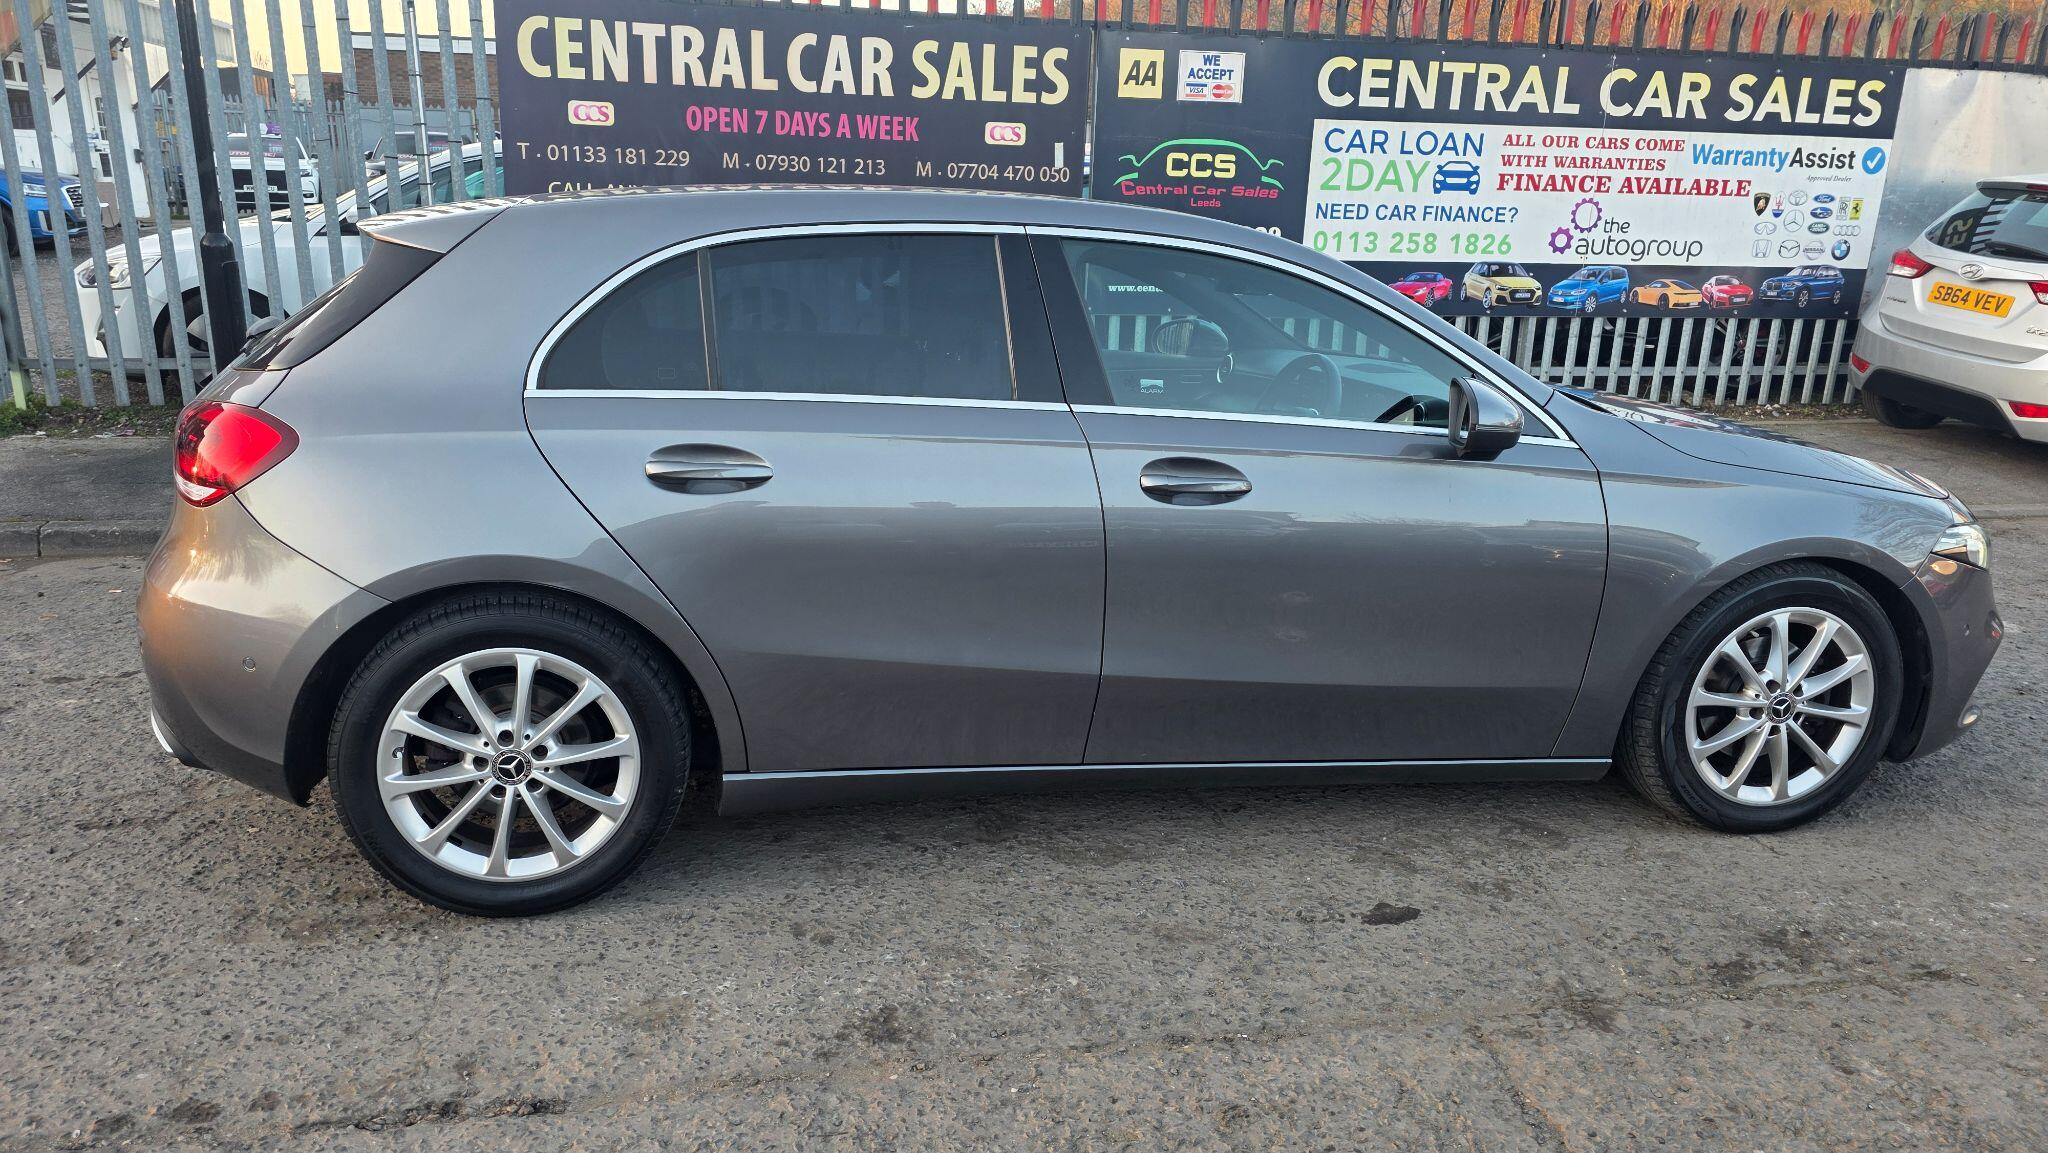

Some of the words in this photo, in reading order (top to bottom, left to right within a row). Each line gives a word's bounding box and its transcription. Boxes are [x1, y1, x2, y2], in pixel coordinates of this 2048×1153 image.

[517, 15, 779, 91] CENTRAL
[786, 32, 895, 97] CAR
[911, 39, 1070, 105] SALES
[1203, 54, 1221, 67] WE
[1123, 60, 1158, 86] AA
[1188, 68, 1234, 80] ACCEPT
[1317, 55, 1580, 115] CENTRAL
[1599, 68, 1711, 120] CAR
[1723, 73, 1886, 127] SALES
[573, 104, 610, 122] CCS
[686, 105, 748, 134] OPEN
[755, 110, 769, 134] 7
[775, 110, 831, 137] DAYS
[836, 113, 851, 138] A
[856, 114, 920, 142] WEEK
[989, 125, 1022, 143] CCS
[1324, 127, 1389, 154] CAR
[1400, 130, 1485, 157] LOAN
[1502, 134, 1536, 148] ALL
[1542, 135, 1579, 149] OUR
[1586, 136, 1630, 150] CARS
[1635, 138, 1685, 152] COME
[547, 144, 607, 163] 01133
[615, 147, 646, 165] 181
[654, 149, 690, 167] 229
[755, 154, 810, 172] 07930
[818, 157, 846, 174] 121
[854, 158, 886, 176] 213
[1166, 152, 1236, 179] CCS
[1500, 154, 1547, 168] WITH
[1554, 156, 1667, 171] WARRANTIES
[947, 162, 998, 180] 07704
[1003, 166, 1034, 182] 470
[1040, 167, 1070, 182] 050
[1320, 157, 1431, 193] 2DAY
[1121, 180, 1188, 196] Central
[1192, 185, 1226, 196] Car
[1231, 185, 1279, 199] Sales
[1497, 173, 1612, 194] FINANCE
[1618, 176, 1752, 198] AVAILABLE
[1190, 197, 1221, 208] Leeds
[1315, 202, 1369, 220] NEED
[1375, 204, 1416, 221] CAR
[1422, 205, 1519, 223] FINANCE?
[1603, 217, 1631, 234] the
[1313, 230, 1378, 253] 0113
[1389, 231, 1438, 254] 258
[1450, 232, 1512, 255] 1826
[1575, 235, 1703, 262] autogroup
[1933, 285, 1971, 306] SB64
[1973, 291, 2007, 313] VEV
